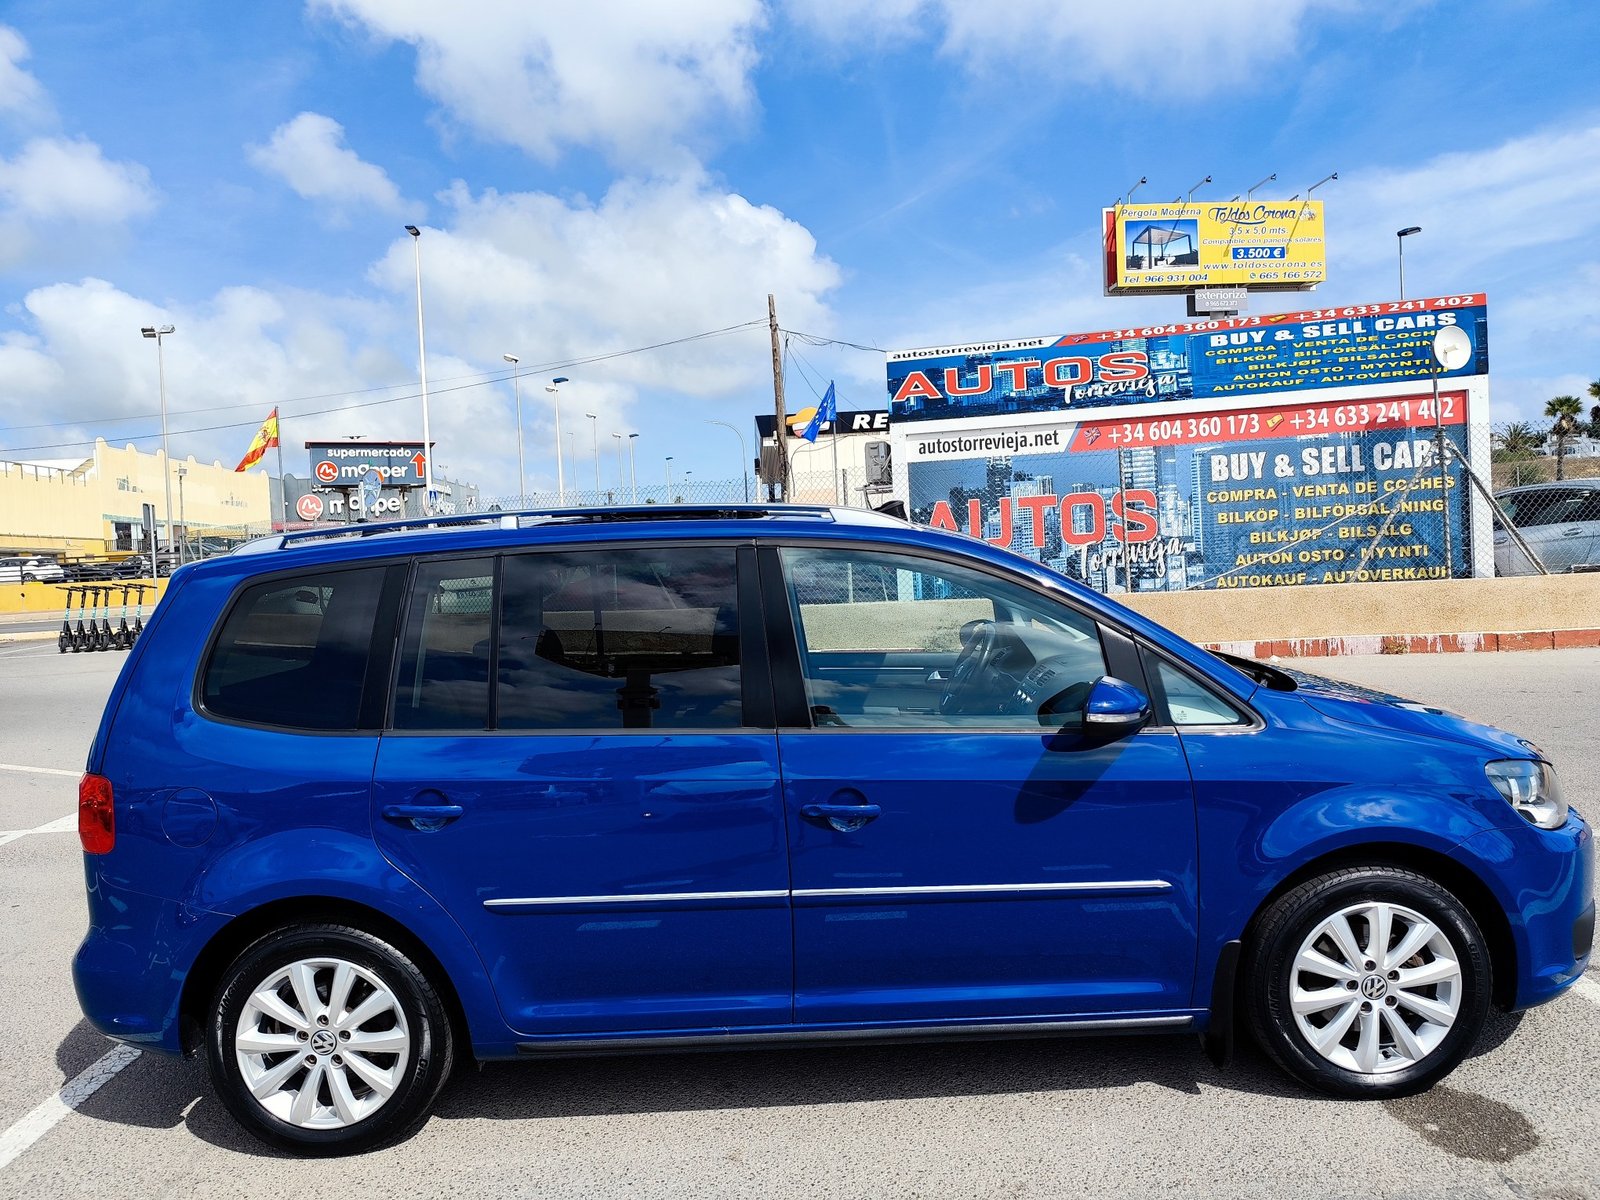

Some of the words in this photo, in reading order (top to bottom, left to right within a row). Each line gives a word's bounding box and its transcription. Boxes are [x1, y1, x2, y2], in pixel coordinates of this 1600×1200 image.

[1121, 208, 1157, 218] Pergola
[1161, 208, 1201, 216] Moderna
[1208, 206, 1250, 224] Toldos
[1254, 205, 1296, 220] Corona
[1236, 248, 1270, 258] 3.500
[1144, 275, 1164, 283] 966
[1166, 274, 1186, 282] 931
[1188, 274, 1208, 282] 004
[1259, 272, 1279, 280] 665
[1282, 271, 1300, 279] 166
[1303, 270, 1322, 278] 572
[1195, 290, 1247, 300] exterioriza
[1294, 310, 1336, 320] +34
[1343, 306, 1380, 316] 633
[1388, 301, 1426, 312] 241
[1434, 296, 1474, 307] 402
[1097, 330, 1136, 340] +34
[1141, 324, 1178, 336] 604
[1182, 320, 1220, 332] 360
[1226, 317, 1262, 328] 173
[1210, 330, 1266, 348] BUY
[1274, 330, 1295, 341] &
[1302, 322, 1366, 338] SELL
[1374, 312, 1457, 332] CARS
[893, 338, 1044, 360] autostorrevieja.net
[1205, 345, 1277, 356] COMPRA
[1292, 338, 1350, 348] VENTA
[1384, 330, 1437, 340] COCH
[1216, 354, 1278, 364] BILKÖP
[1294, 340, 1432, 357] BILFÖRSÄLJNIN
[1233, 370, 1291, 381] AUTON
[1297, 366, 1344, 375] OSTO
[1360, 358, 1430, 370] MYYNTI
[1248, 358, 1322, 370] BILKJØP
[1338, 350, 1414, 363] BILSALG
[892, 351, 1149, 402] AUTOS
[1212, 378, 1304, 392] AUTOKAUF
[1058, 373, 1177, 404] Torrevieja
[1289, 408, 1328, 430] +34
[1334, 404, 1370, 426] 633
[1376, 401, 1410, 423] 241
[1418, 396, 1454, 420] 402
[1108, 423, 1144, 444] +34
[1150, 420, 1182, 441] 604
[1188, 416, 1220, 438] 360
[1226, 414, 1260, 434] 173
[918, 430, 1060, 454] autostorrevieja.net
[327, 447, 412, 460] supermercado
[1210, 452, 1266, 482] BUY
[1274, 454, 1295, 478] &
[1302, 445, 1366, 476] SELL
[1373, 438, 1452, 471] CARS
[1206, 488, 1277, 503] COMPRA
[1292, 483, 1350, 498] VENTA
[1355, 481, 1378, 494] DE
[929, 489, 1158, 550] AUTOS
[1218, 508, 1278, 524] BILKÖP
[1250, 528, 1322, 544] BILKJØP
[1077, 536, 1184, 579] Torrvieja
[1236, 552, 1293, 566] AUTON
[1298, 549, 1344, 562] OSTO
[1216, 573, 1306, 588] AUTOKAUF
